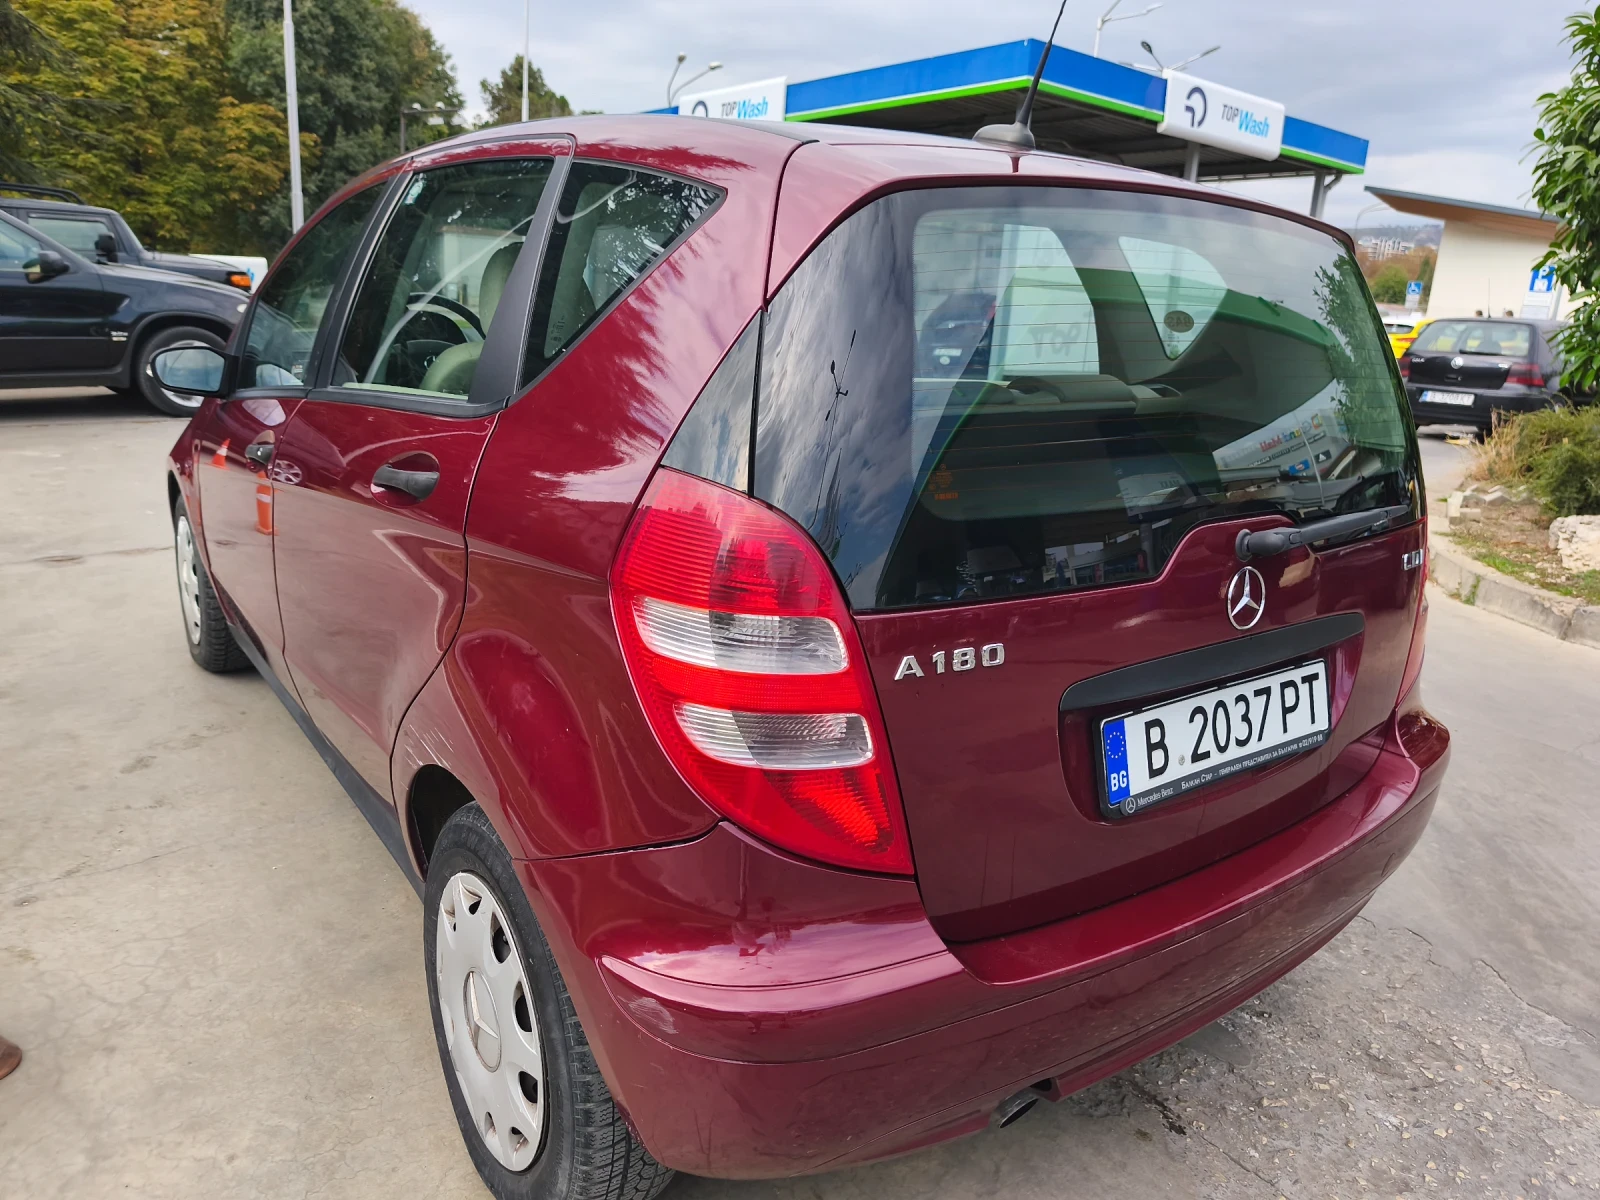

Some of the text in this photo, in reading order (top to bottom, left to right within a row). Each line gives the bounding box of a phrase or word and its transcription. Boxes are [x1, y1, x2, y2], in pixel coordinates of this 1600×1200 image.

[894, 643, 1005, 681] A 180
[1144, 672, 1320, 780] B 2037 PT
[1110, 770, 1128, 792] BG
